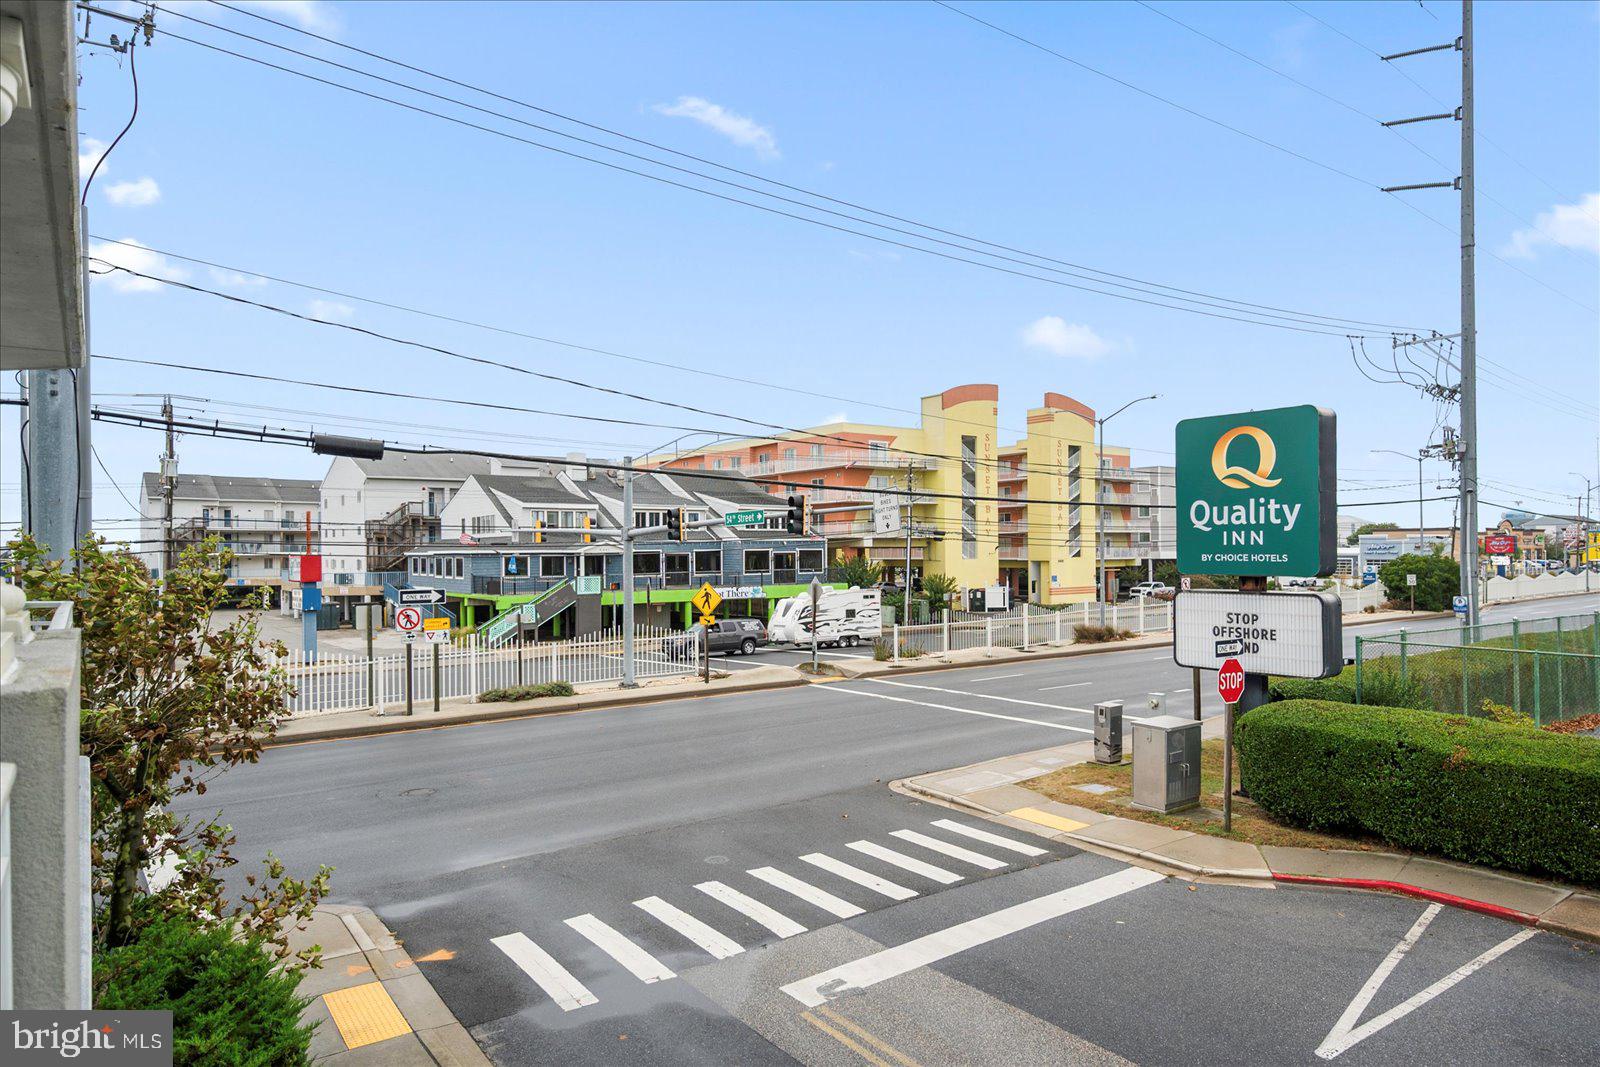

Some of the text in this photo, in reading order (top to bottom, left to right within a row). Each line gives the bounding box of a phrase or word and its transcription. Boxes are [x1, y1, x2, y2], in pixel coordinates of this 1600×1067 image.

[737, 512, 755, 523] Street
[1190, 497, 1301, 532] Quality
[1223, 530, 1264, 546] INN
[1201, 553, 1289, 563] BY CHOICE HOTELS
[726, 589, 749, 598] There
[1226, 612, 1259, 625] STOP
[1212, 625, 1277, 641] OFFSHORE
[1218, 643, 1238, 653] ONE WAY
[1219, 671, 1243, 690] STOP
